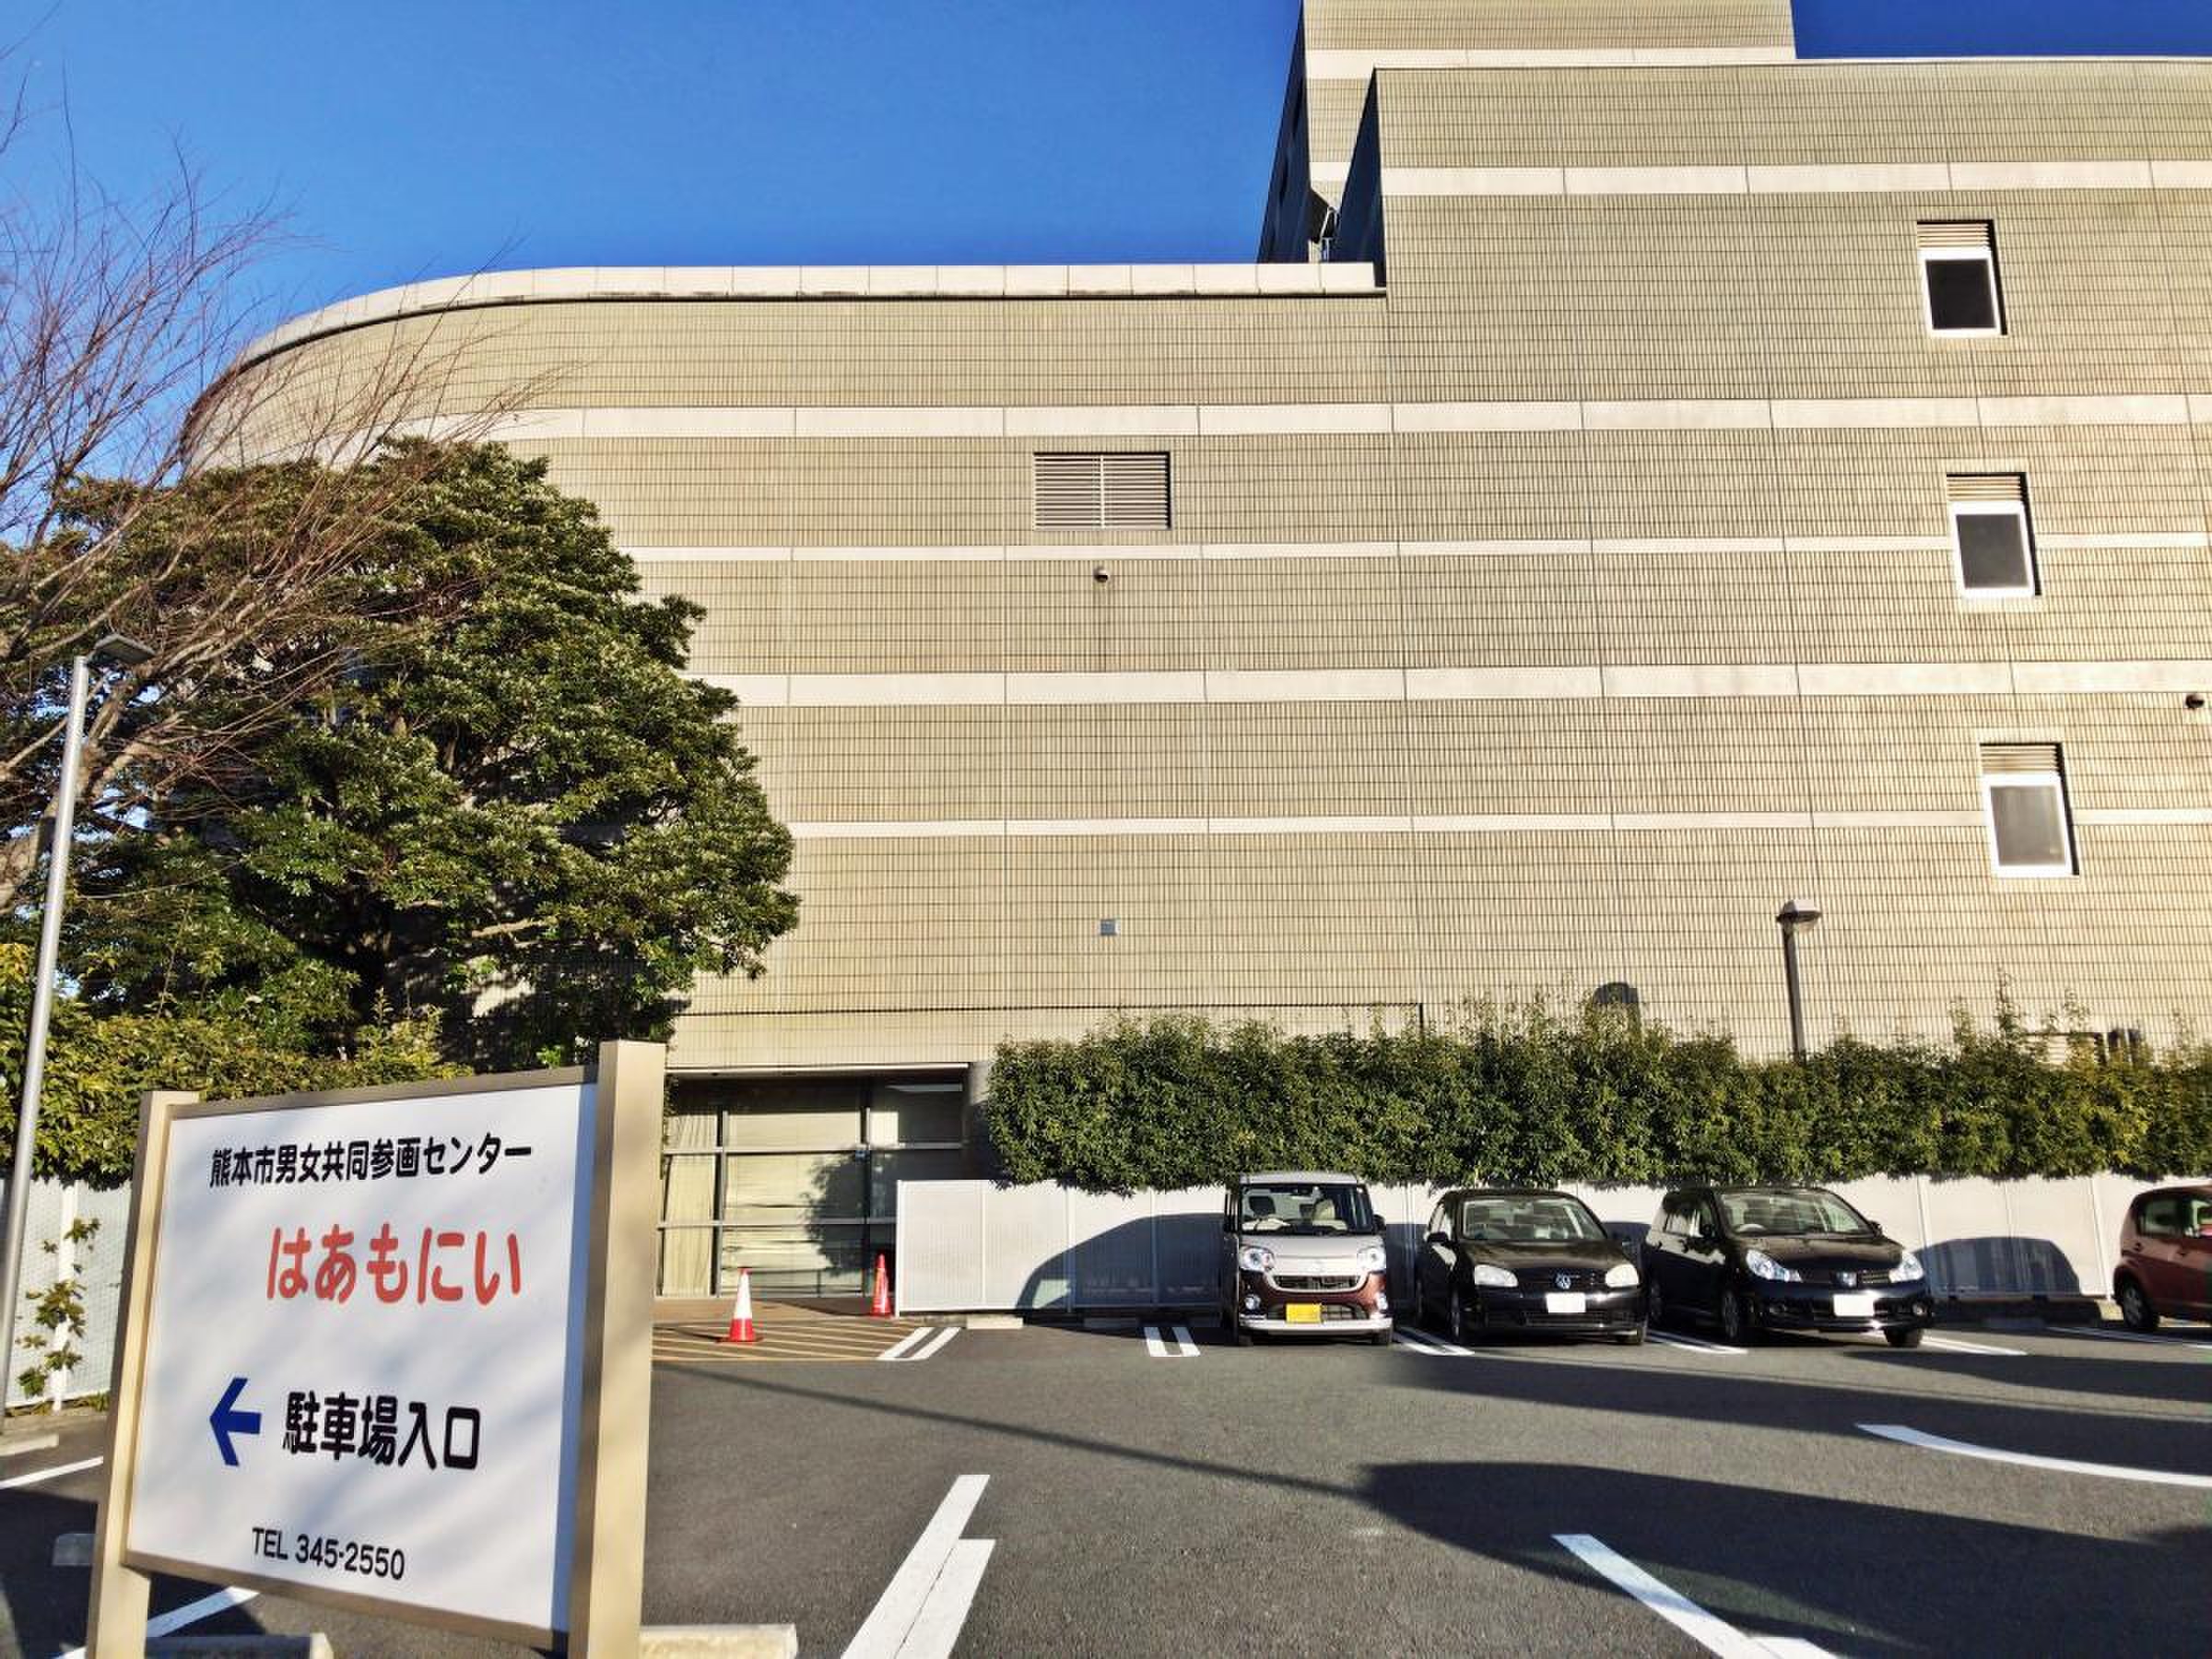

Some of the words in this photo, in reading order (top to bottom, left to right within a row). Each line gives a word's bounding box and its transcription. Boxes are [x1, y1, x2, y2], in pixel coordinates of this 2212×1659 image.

[209, 1132, 532, 1187] 熊本市男女共同参画センター
[267, 1222, 522, 1305] はあもにい
[283, 1391, 481, 1470] 駐車場入口
[252, 1526, 288, 1560] TEL
[296, 1534, 406, 1581] 345-2550
